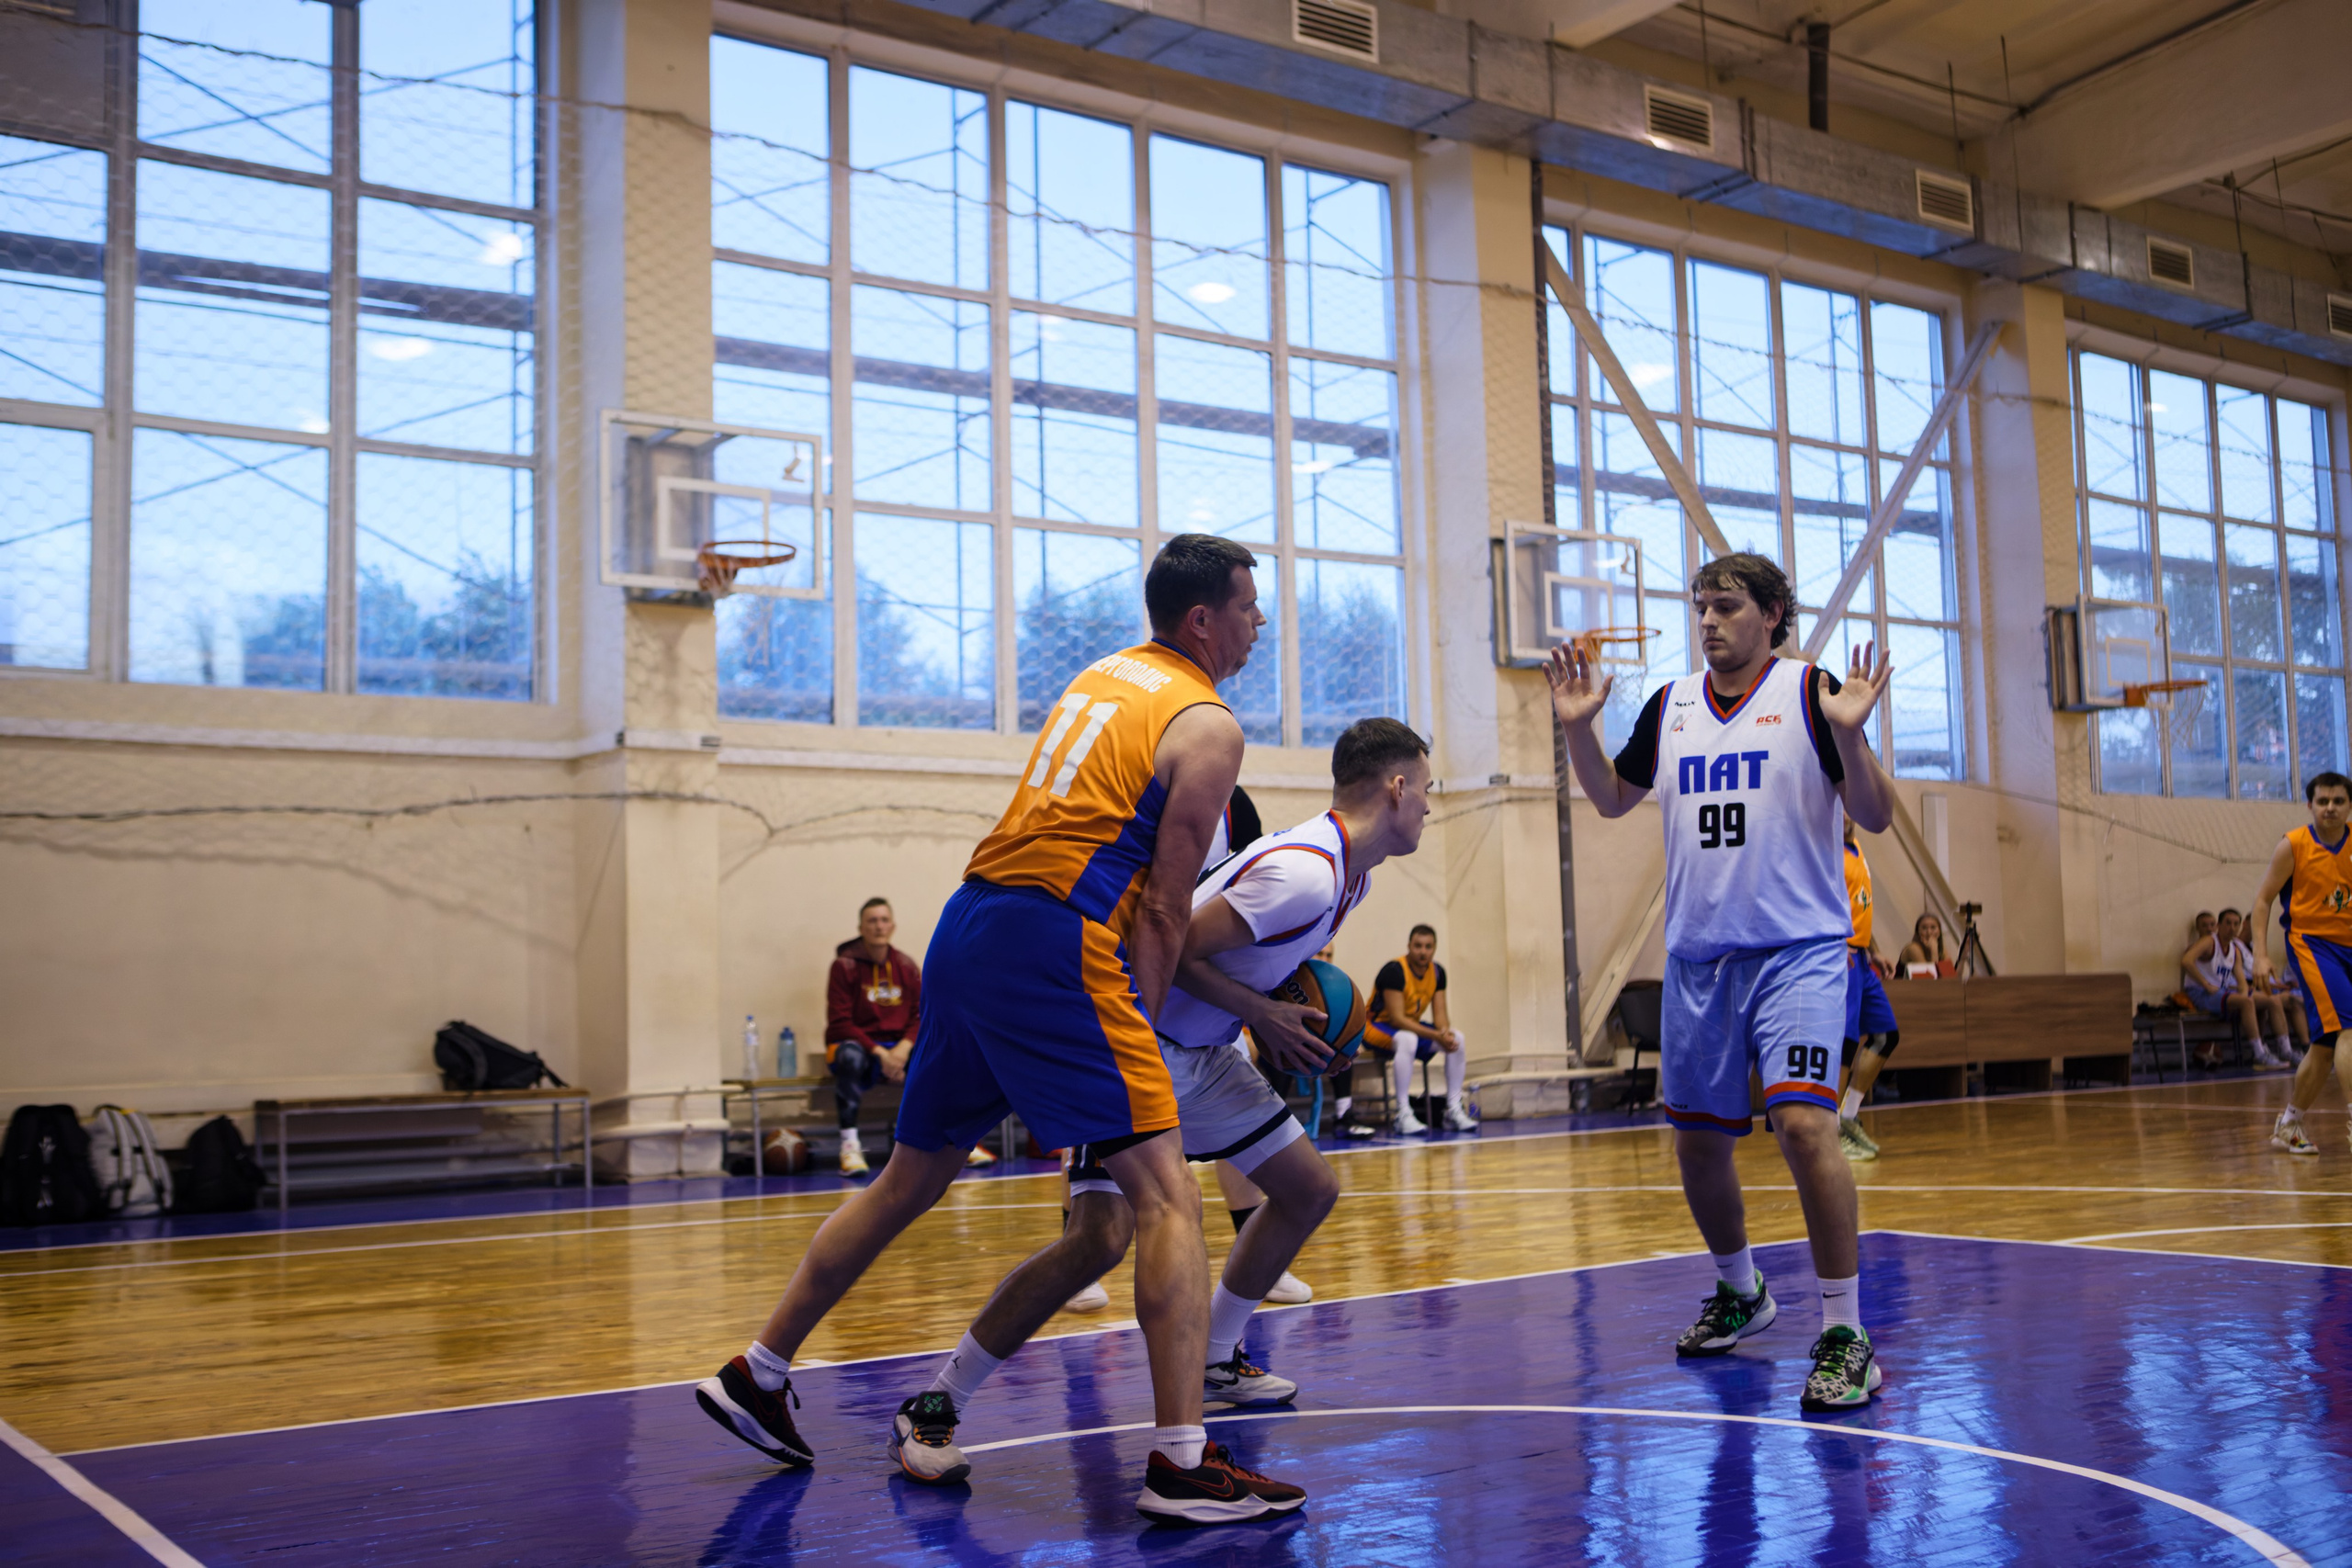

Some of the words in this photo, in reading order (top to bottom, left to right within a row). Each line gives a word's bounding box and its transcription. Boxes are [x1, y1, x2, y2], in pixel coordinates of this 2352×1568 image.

[1027, 694, 1119, 798] 11
[1679, 750, 1769, 795] ПАТ
[1699, 802, 1746, 849] 99
[1788, 1045, 1828, 1081] 99
